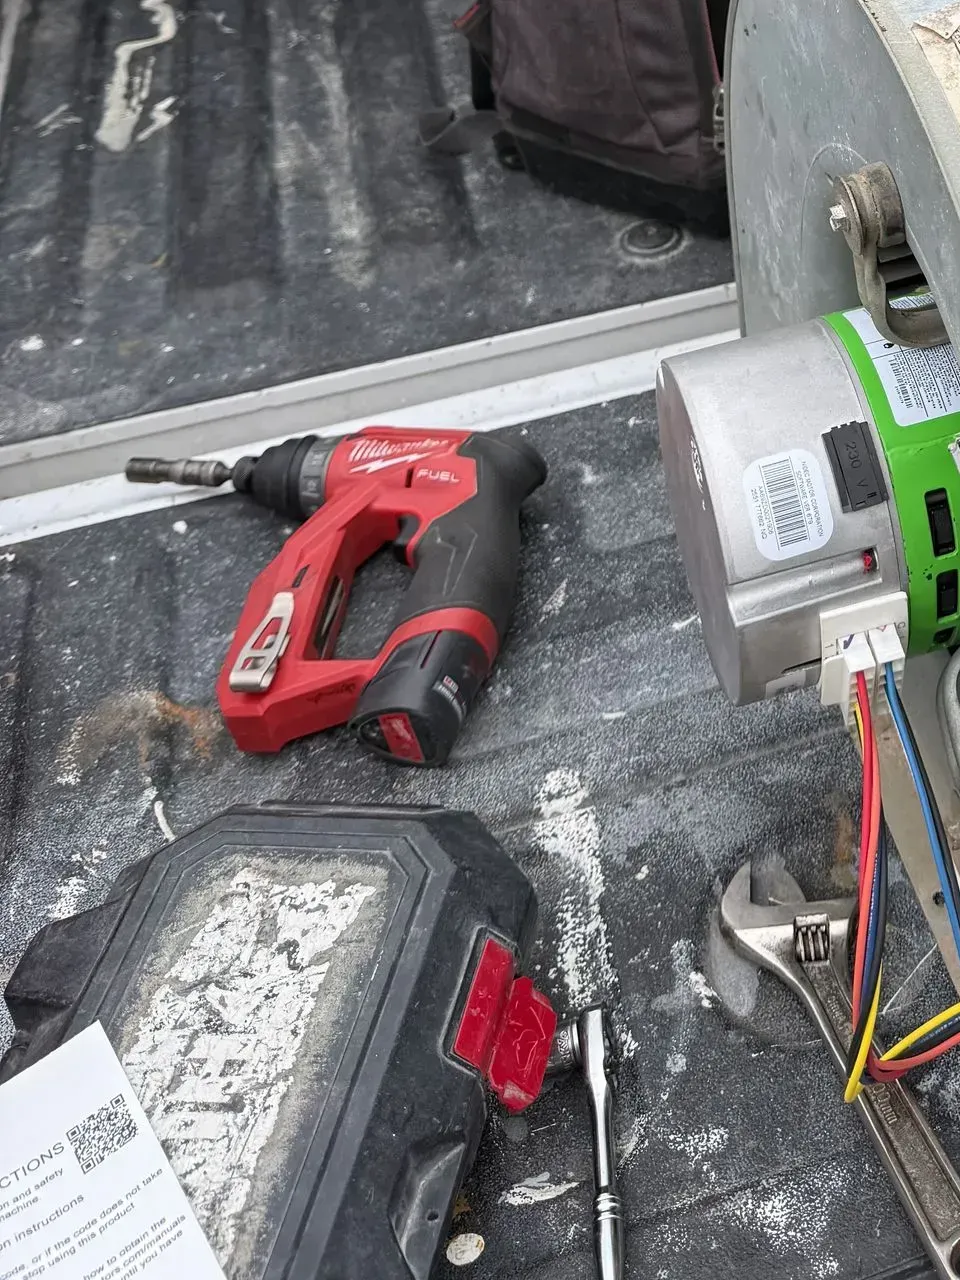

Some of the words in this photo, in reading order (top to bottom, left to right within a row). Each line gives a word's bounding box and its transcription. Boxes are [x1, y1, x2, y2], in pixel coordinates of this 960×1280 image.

[417, 468, 460, 483] FUEL
[845, 442, 862, 468] 230
[0, 1141, 65, 1189] CTIONS
[12, 1187, 32, 1203] and
[34, 1167, 63, 1191] safety
[14, 1194, 85, 1242] instructions
[53, 1235, 71, 1252] the
[73, 1218, 98, 1238] code
[99, 1201, 125, 1220] does
[142, 1167, 164, 1185] take
[77, 1231, 97, 1248] this
[98, 1200, 136, 1235] product
[119, 1231, 149, 1257] obtain
[150, 1215, 167, 1232] the
[139, 1250, 158, 1269] you
[159, 1229, 184, 1252] have
